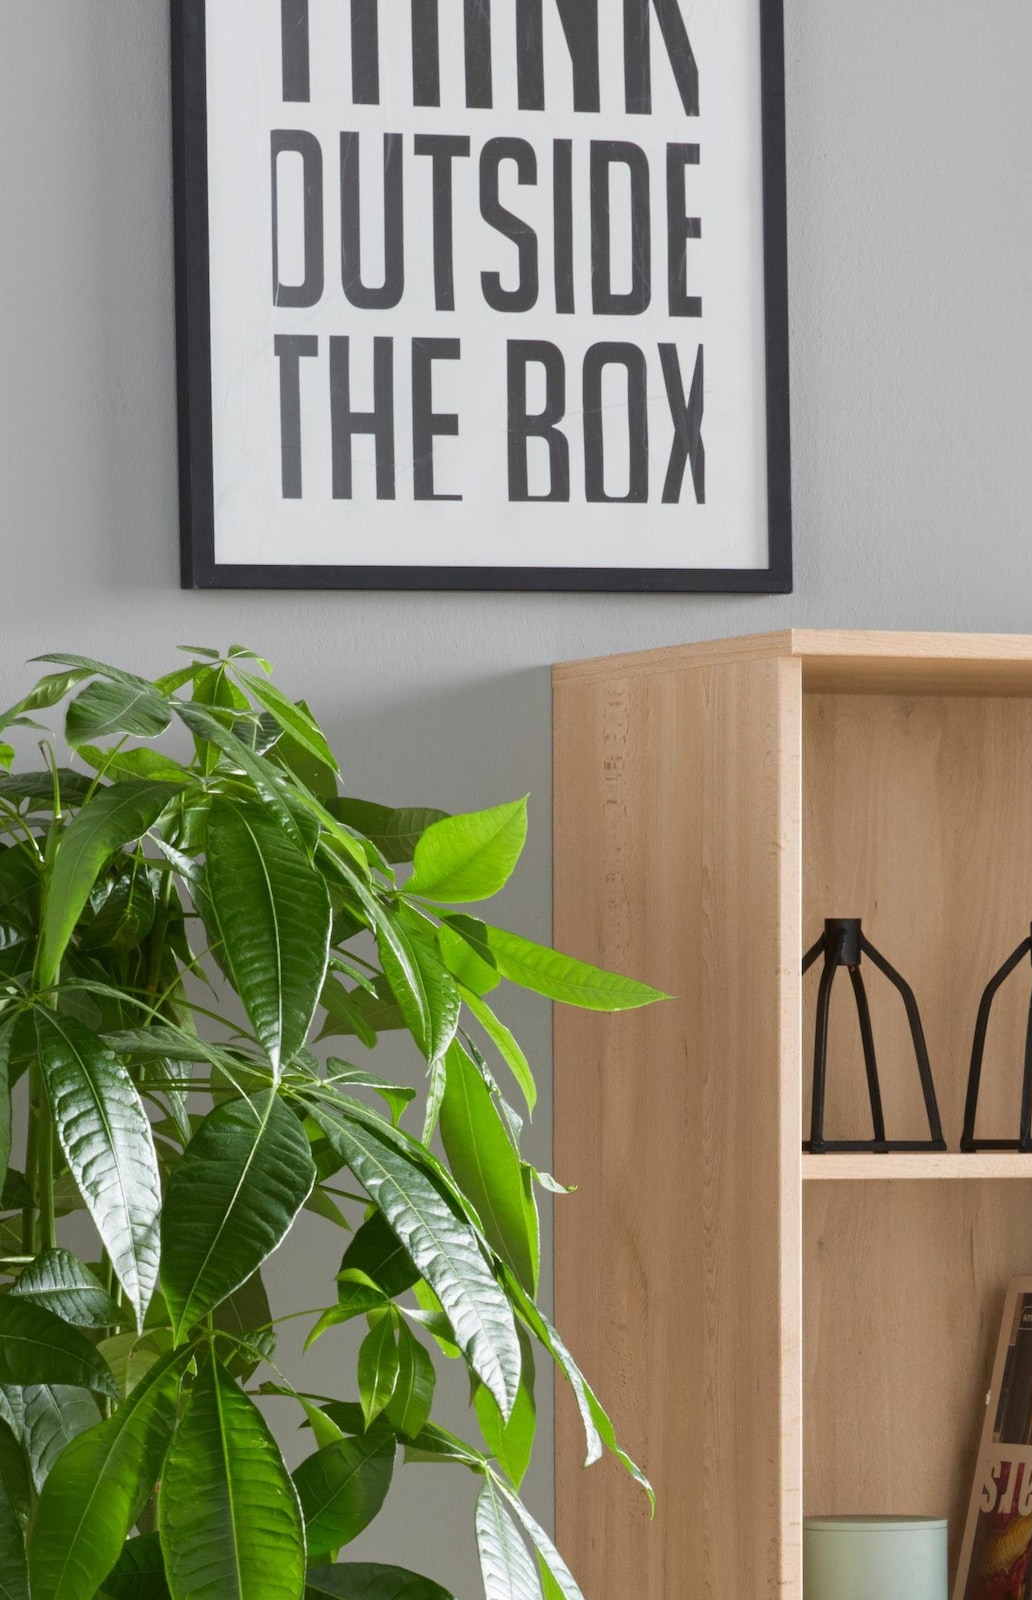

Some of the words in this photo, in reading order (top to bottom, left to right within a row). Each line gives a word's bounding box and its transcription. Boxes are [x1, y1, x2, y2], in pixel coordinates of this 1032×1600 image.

[270, 129, 703, 318] OUTSIDE
[273, 333, 464, 502] THE
[506, 338, 707, 505] BOX
